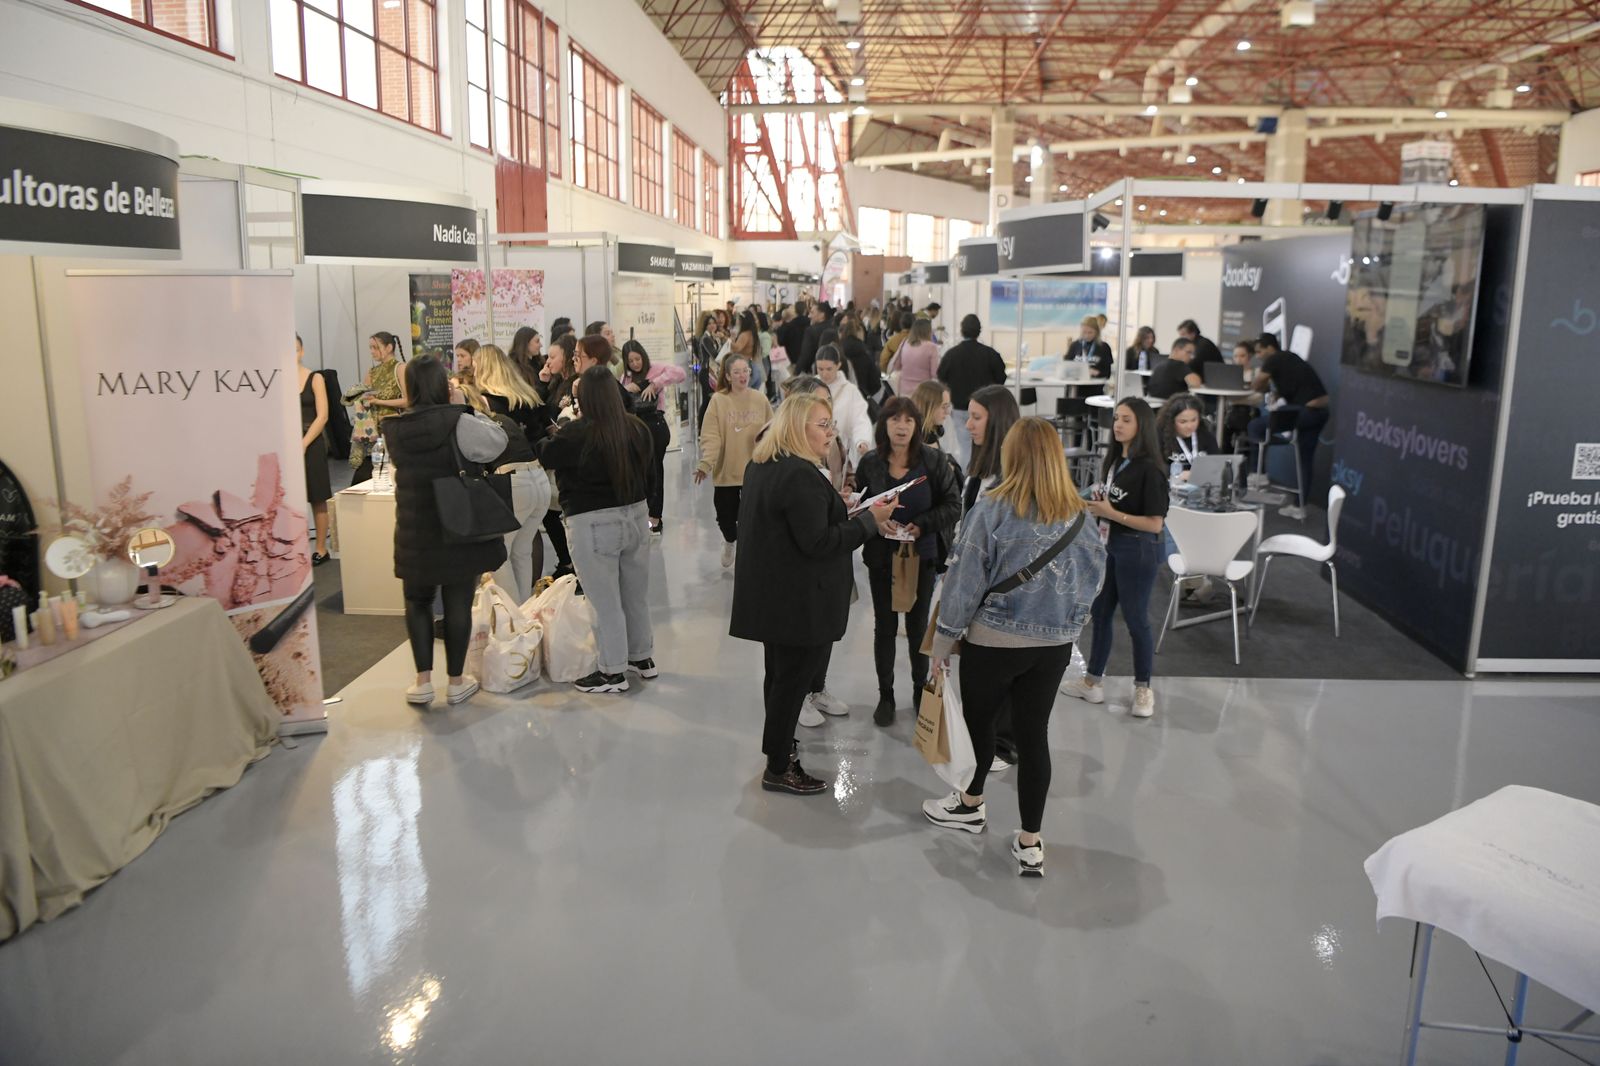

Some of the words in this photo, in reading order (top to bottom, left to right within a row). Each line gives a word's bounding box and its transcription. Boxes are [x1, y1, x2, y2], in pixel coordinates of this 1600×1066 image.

[103, 181, 131, 214] de
[996, 194, 1008, 208] D
[433, 223, 462, 244] Nadia
[1221, 261, 1263, 292] booksy
[97, 370, 201, 401] MARY
[214, 368, 279, 399] KAY
[1356, 411, 1469, 470] Booksylovers
[1527, 490, 1593, 508] ¡Prueba
